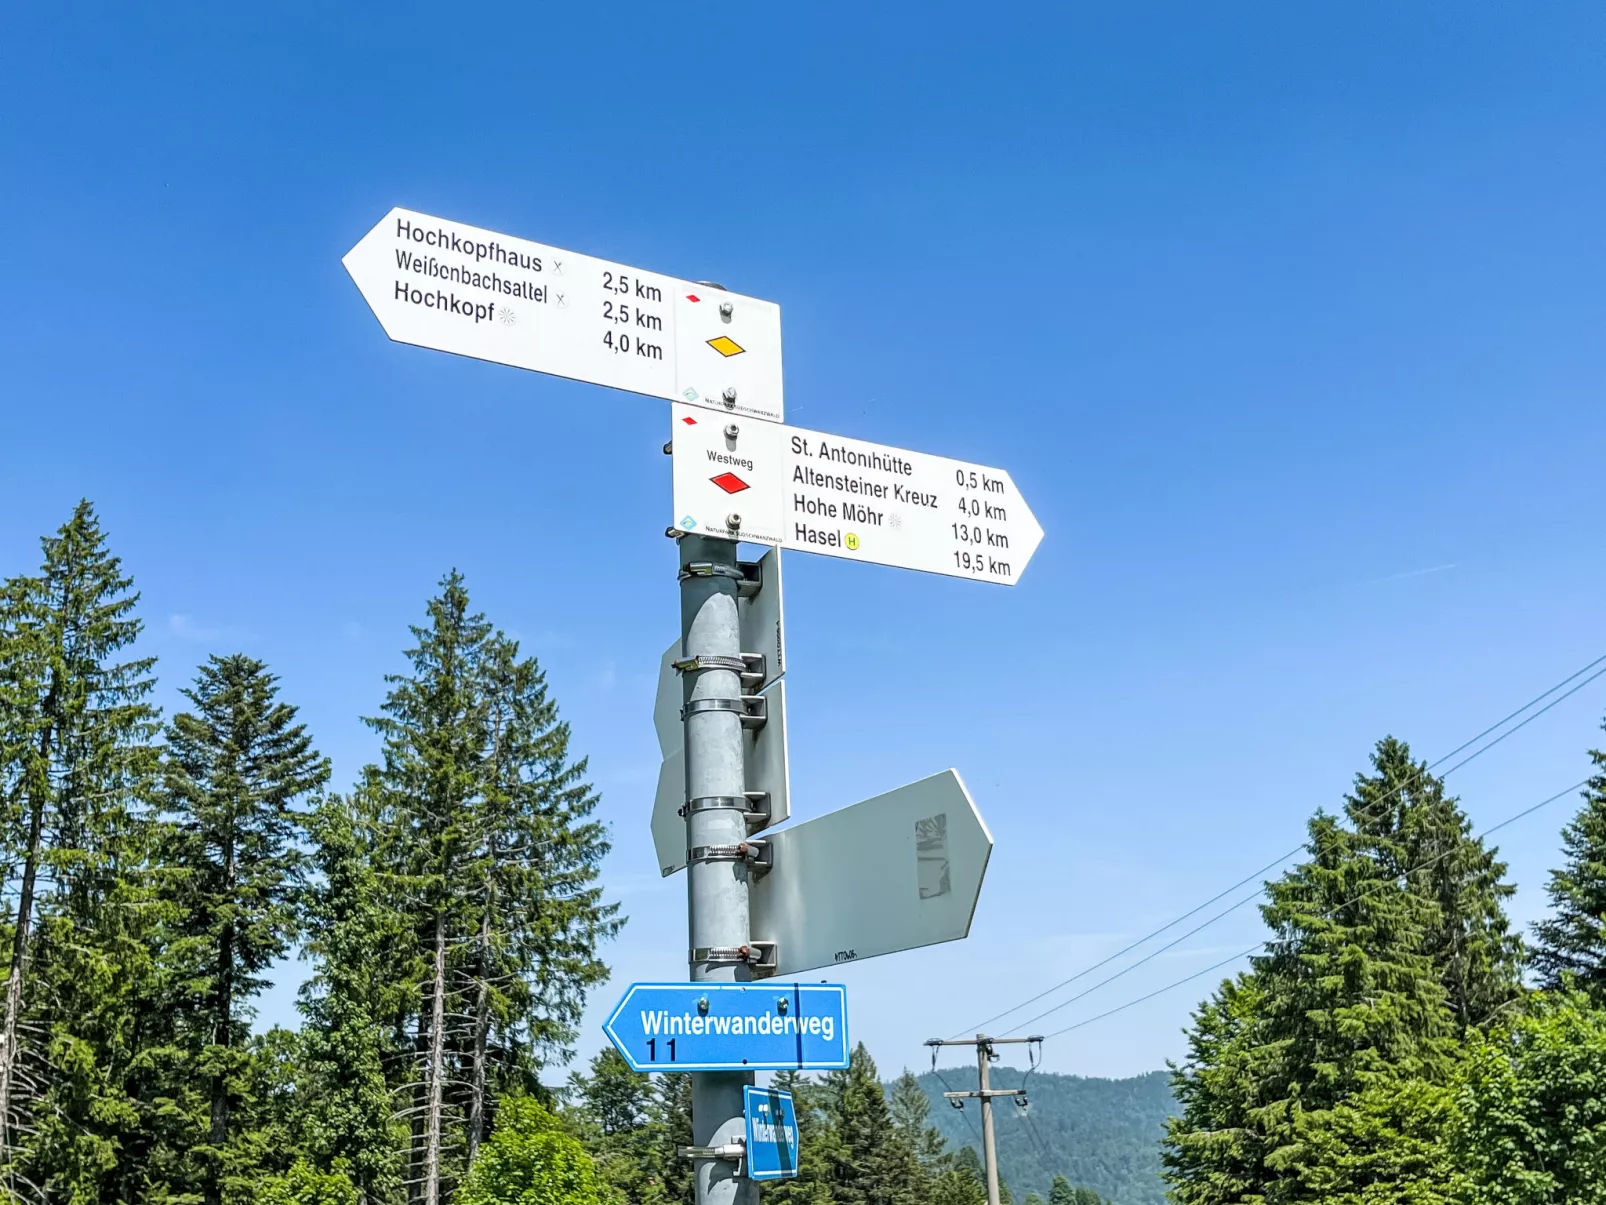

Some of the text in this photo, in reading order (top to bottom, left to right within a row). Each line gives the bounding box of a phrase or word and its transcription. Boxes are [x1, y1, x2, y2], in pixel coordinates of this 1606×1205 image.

[396, 218, 662, 302] Hochkopfhaus 2,5 km
[395, 248, 662, 331] Weißenbachsattel 2,5 km
[394, 280, 663, 360] Hochkopf 4,0 km
[706, 449, 753, 472] Westweg
[791, 435, 1004, 494] St. Antonihütte 0,5 km
[793, 464, 1007, 521] Altensteiner Kreuz 4,0 km
[794, 493, 1009, 549] Hohe Möhr 13,0 km
[795, 522, 841, 547] Hasel
[953, 550, 984, 574] 19,5
[988, 555, 1011, 576] km
[640, 1010, 834, 1041] Winterwanderweg
